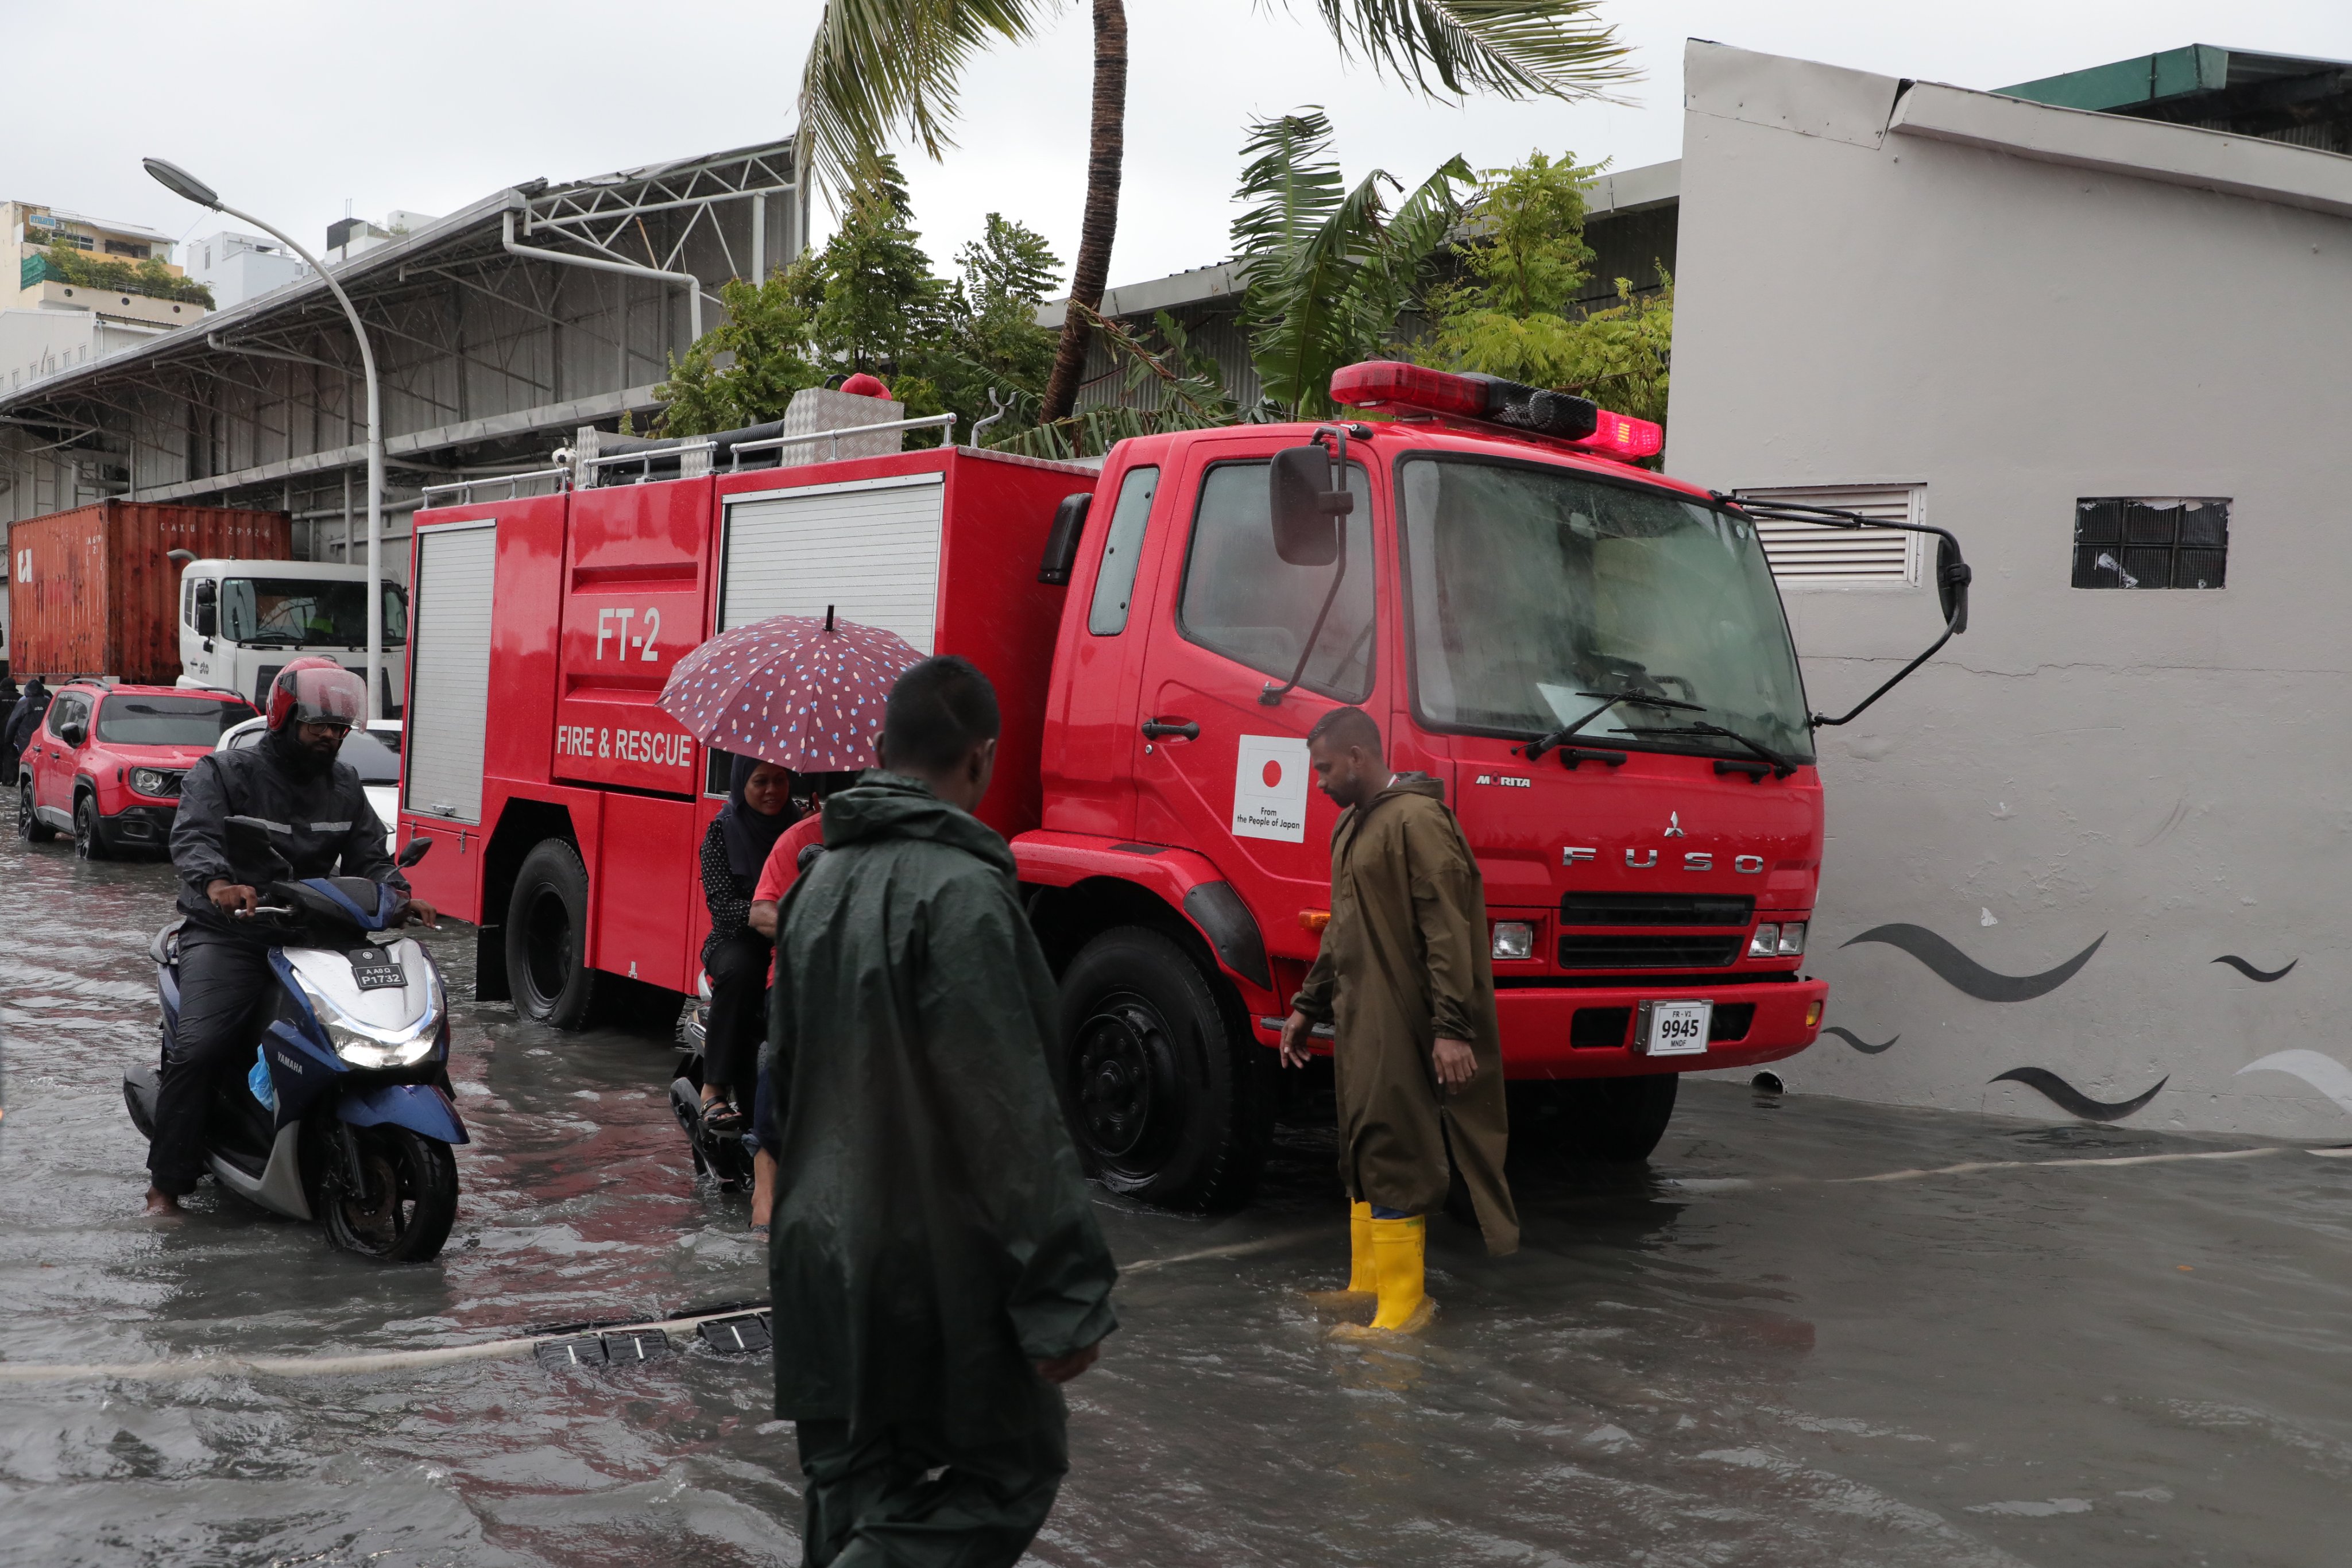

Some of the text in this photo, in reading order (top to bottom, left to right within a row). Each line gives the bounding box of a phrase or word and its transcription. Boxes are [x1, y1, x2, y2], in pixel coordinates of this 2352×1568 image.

[597, 607, 660, 661] FT-2
[557, 725, 691, 766] FIRE & RESCUE
[1475, 771, 1530, 787] MORITA
[1261, 807, 1276, 816] From
[1237, 814, 1299, 830] the People of Japan
[1562, 847, 1763, 874] FUSO
[362, 974, 401, 984] P1732
[1662, 1019, 1699, 1038] 9945
[278, 1051, 303, 1075] YAMAHA
